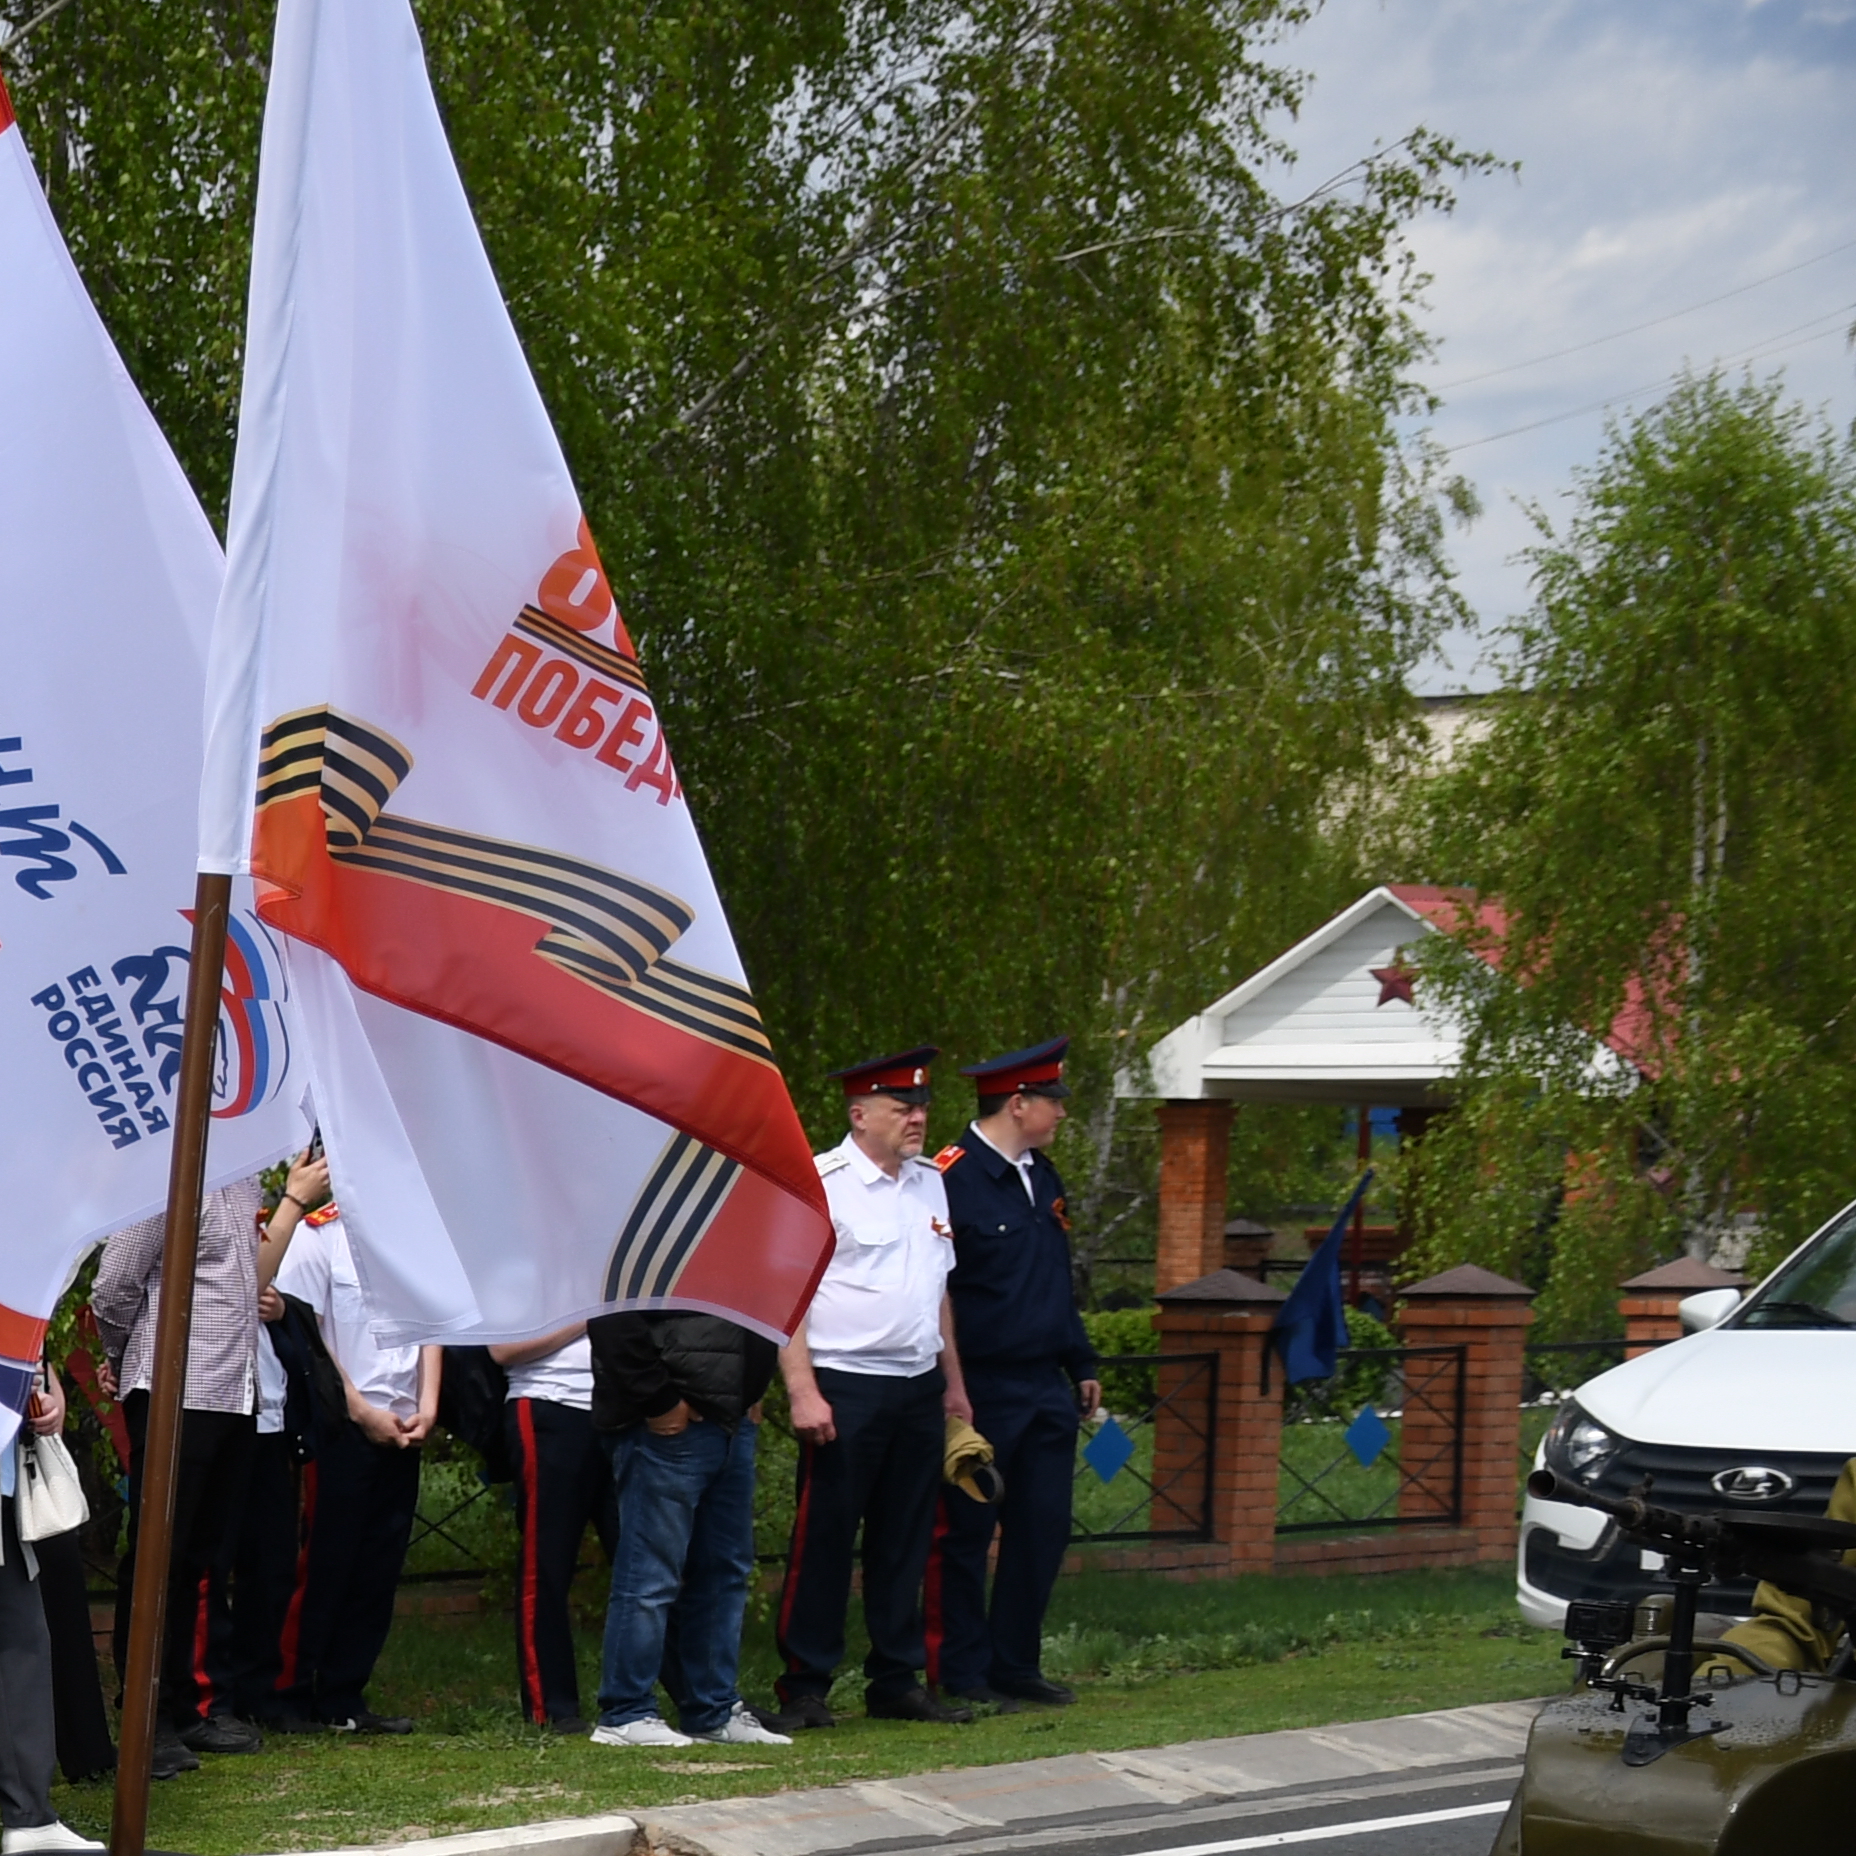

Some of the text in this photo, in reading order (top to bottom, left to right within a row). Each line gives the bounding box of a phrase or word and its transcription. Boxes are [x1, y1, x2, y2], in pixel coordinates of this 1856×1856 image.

[470, 632, 681, 807] ПОБЕД
[30, 983, 141, 1150] РОССИЯ
[66, 964, 171, 1135] ЕДИНАЯ
